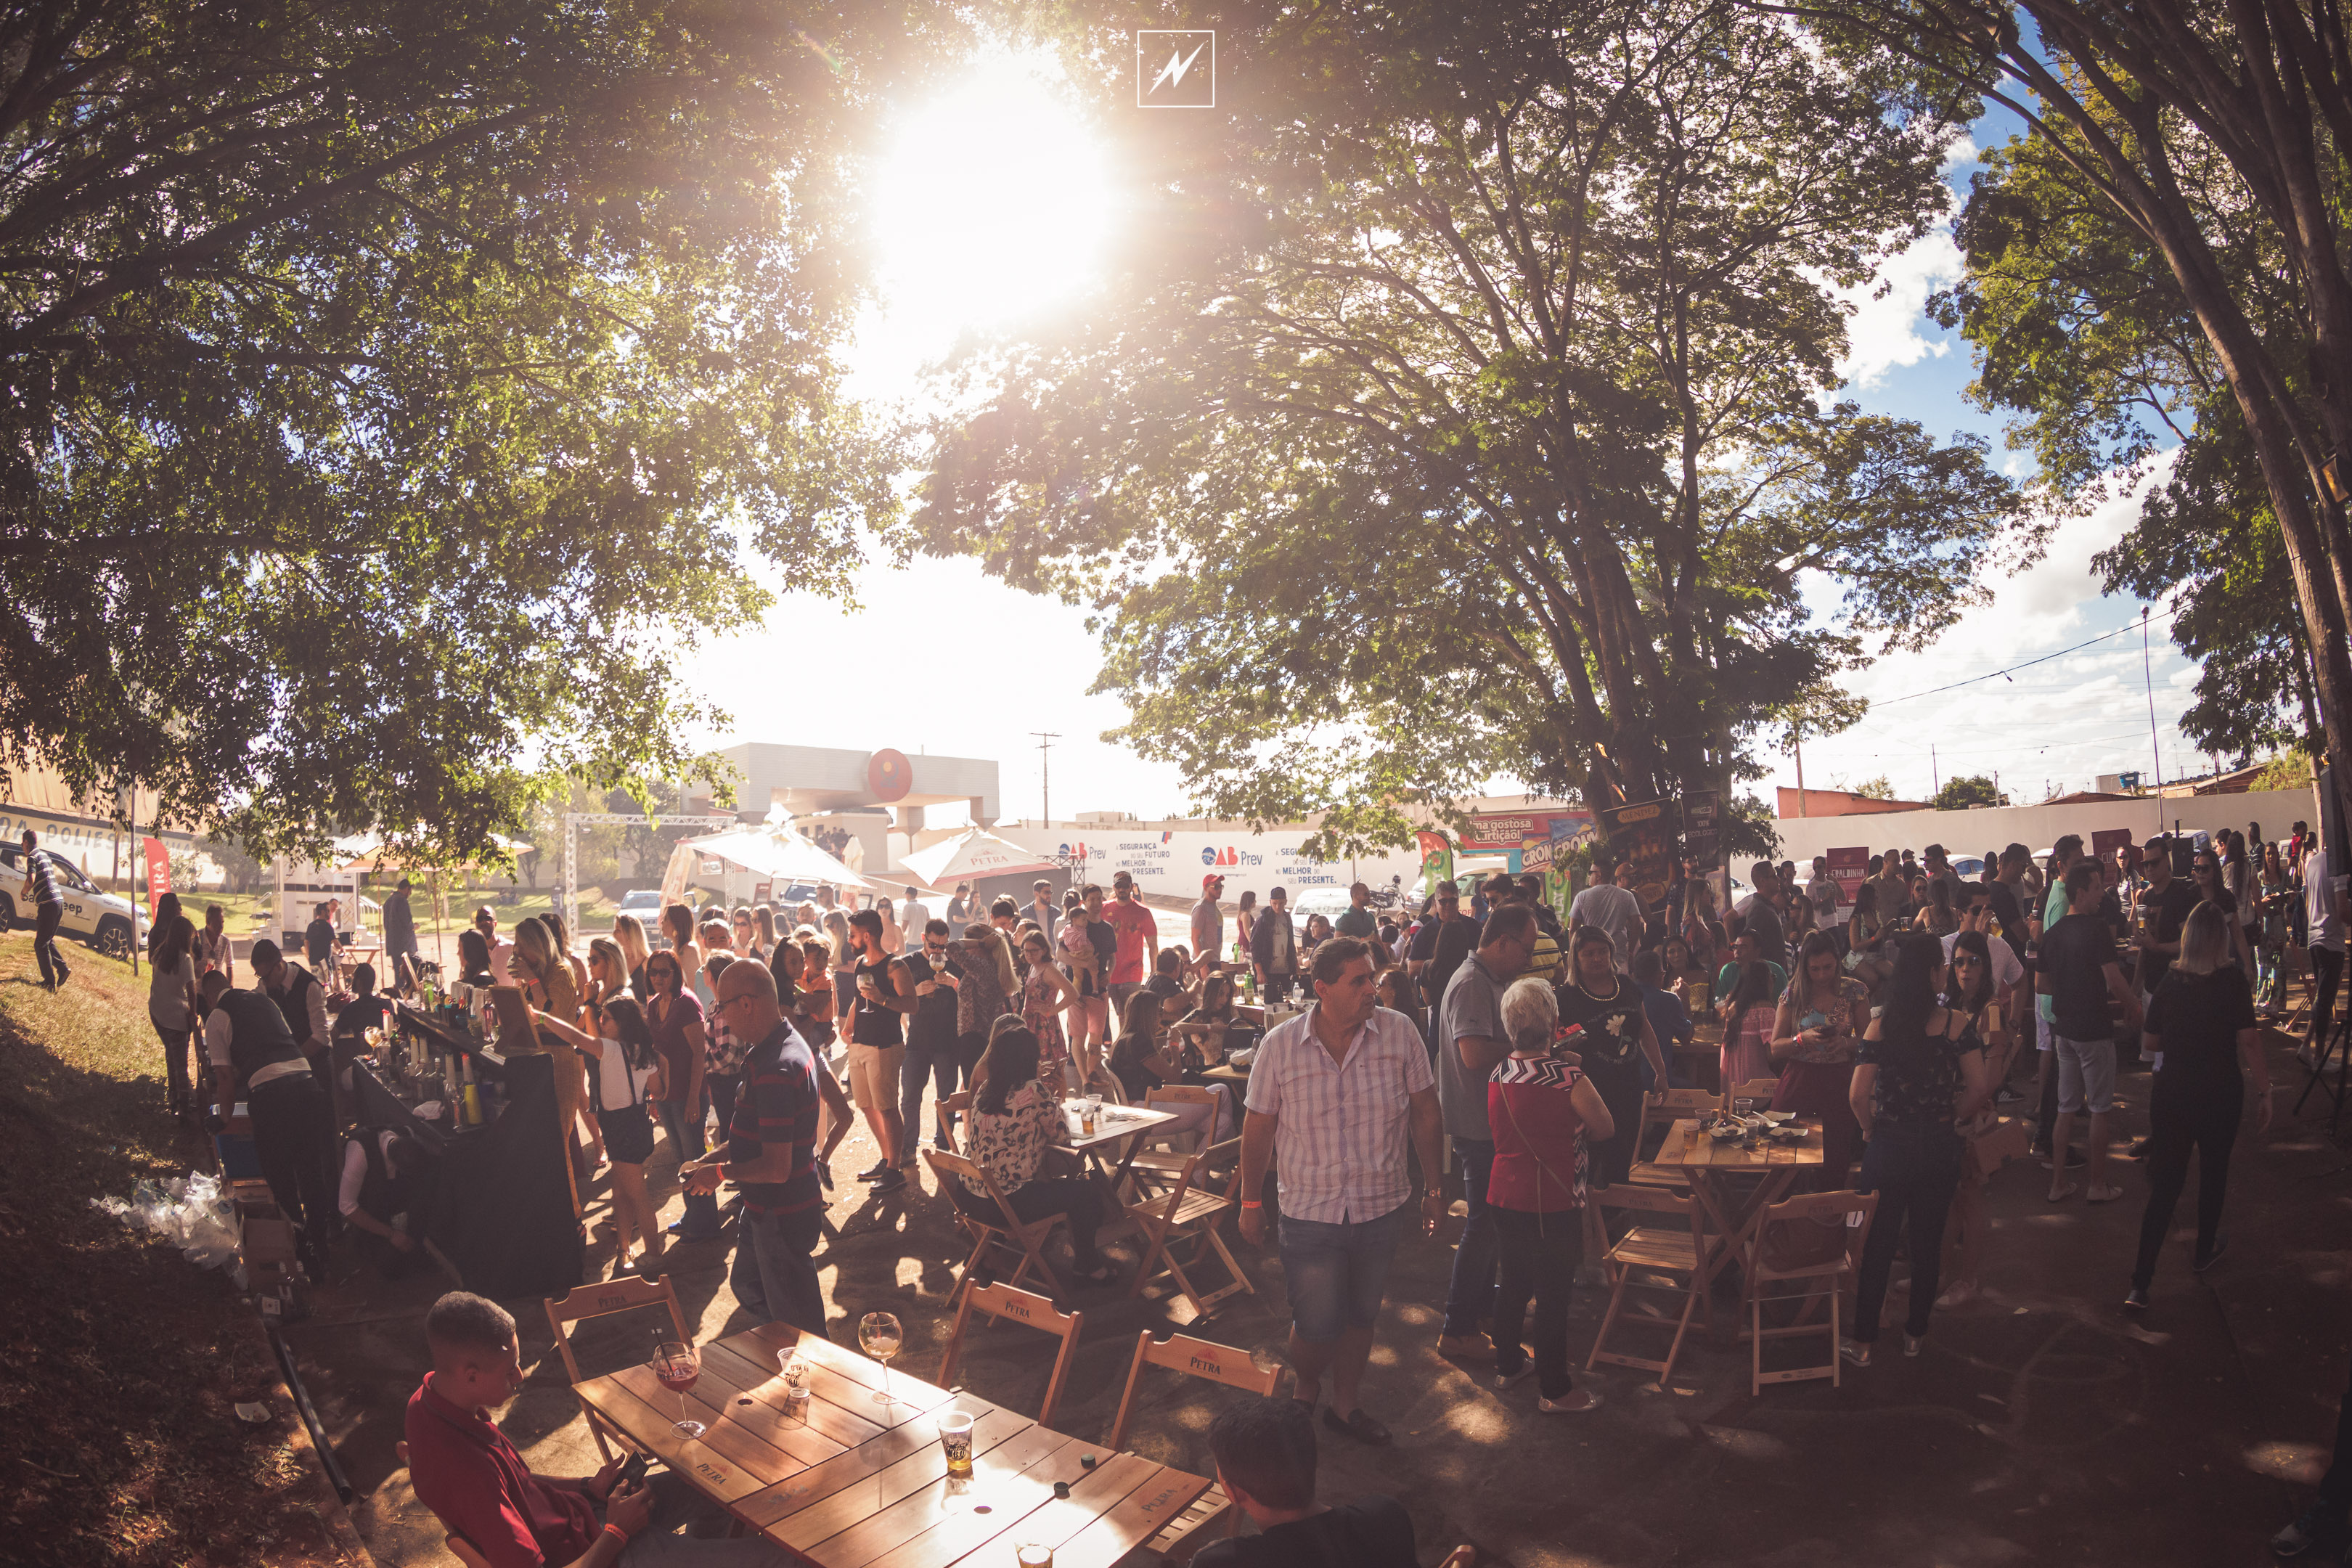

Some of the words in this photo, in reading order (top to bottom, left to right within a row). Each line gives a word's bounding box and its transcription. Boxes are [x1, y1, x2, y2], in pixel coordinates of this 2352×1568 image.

[1490, 819, 1532, 832] gostosa
[1090, 846, 1106, 859] Prev
[1201, 846, 1238, 865] OAB
[1241, 851, 1262, 866] Prev
[970, 855, 1009, 866] PETRA
[1298, 875, 1337, 884] PRESENTE.
[597, 1294, 627, 1307] PETRA
[1005, 1300, 1029, 1318] PETRA
[1190, 1356, 1220, 1375] PETRA
[696, 1463, 727, 1485] PETRA
[1140, 1489, 1178, 1513] PETRA
